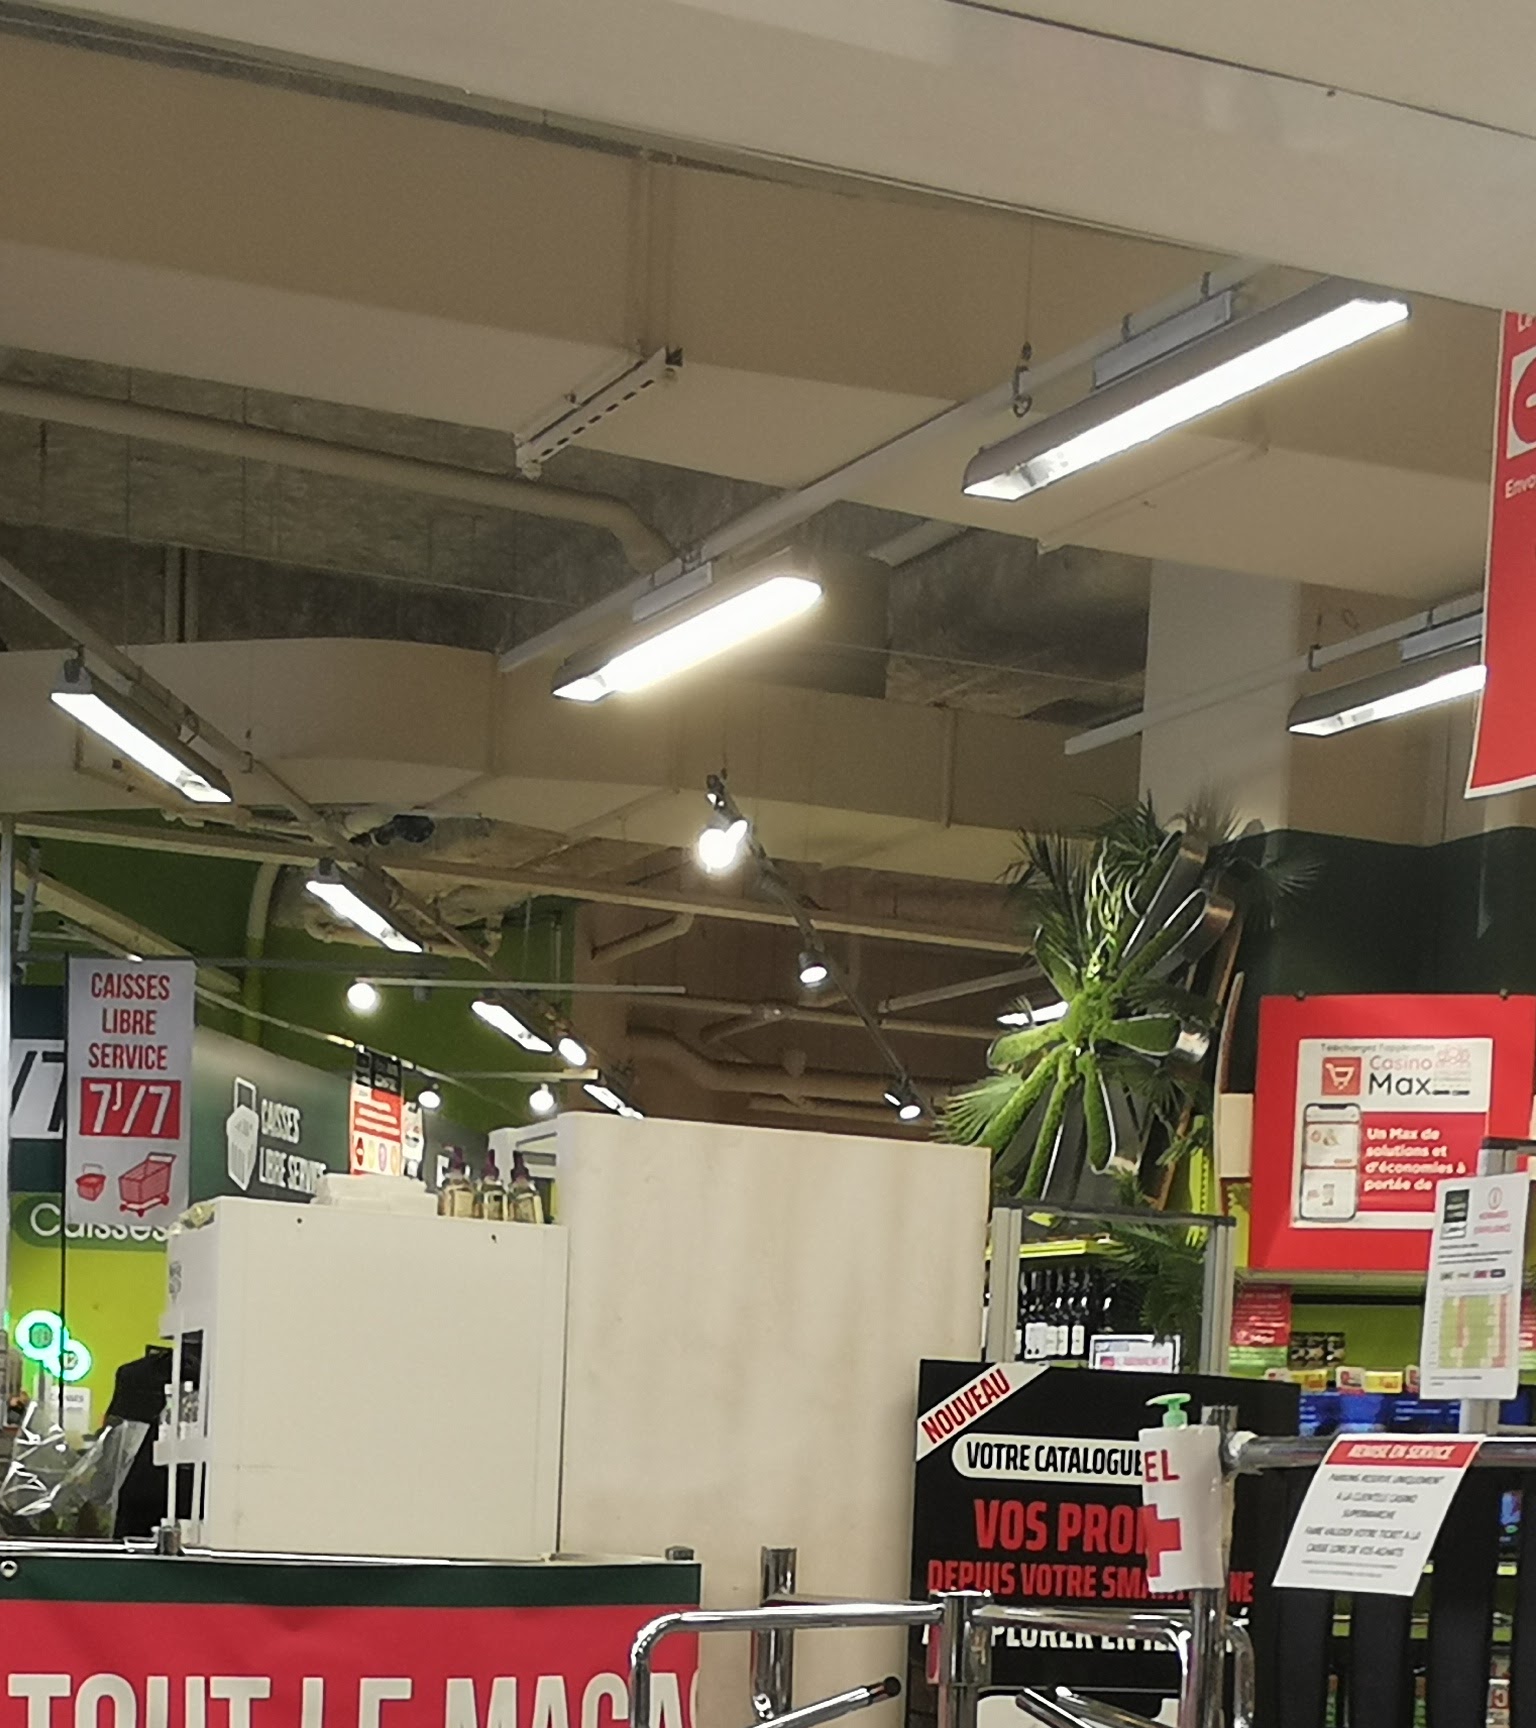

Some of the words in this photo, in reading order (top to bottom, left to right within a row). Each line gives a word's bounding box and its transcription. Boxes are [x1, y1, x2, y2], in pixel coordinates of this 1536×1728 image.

[91, 972, 170, 1000] CAISSES
[101, 1008, 157, 1035] LIBRE
[88, 1043, 168, 1070] SERVICE
[1369, 1055, 1433, 1071] Casino
[1368, 1073, 1432, 1096] Max
[1366, 1128, 1386, 1140] Un
[1389, 1128, 1418, 1140] Max
[1421, 1128, 1440, 1140] de
[1366, 1145, 1429, 1157] solutions
[1432, 1145, 1447, 1157] et
[1365, 1161, 1453, 1174] d'économies
[1365, 1179, 1411, 1191] portée
[1414, 1178, 1432, 1190] de
[920, 1367, 1012, 1445] NOUVEAU
[965, 1440, 1030, 1470] VOTRE
[1144, 1449, 1180, 1483] EL
[973, 1499, 1049, 1551] VOS
[927, 1559, 1015, 1595] DEPUIS
[1020, 1562, 1097, 1597] VOTRE
